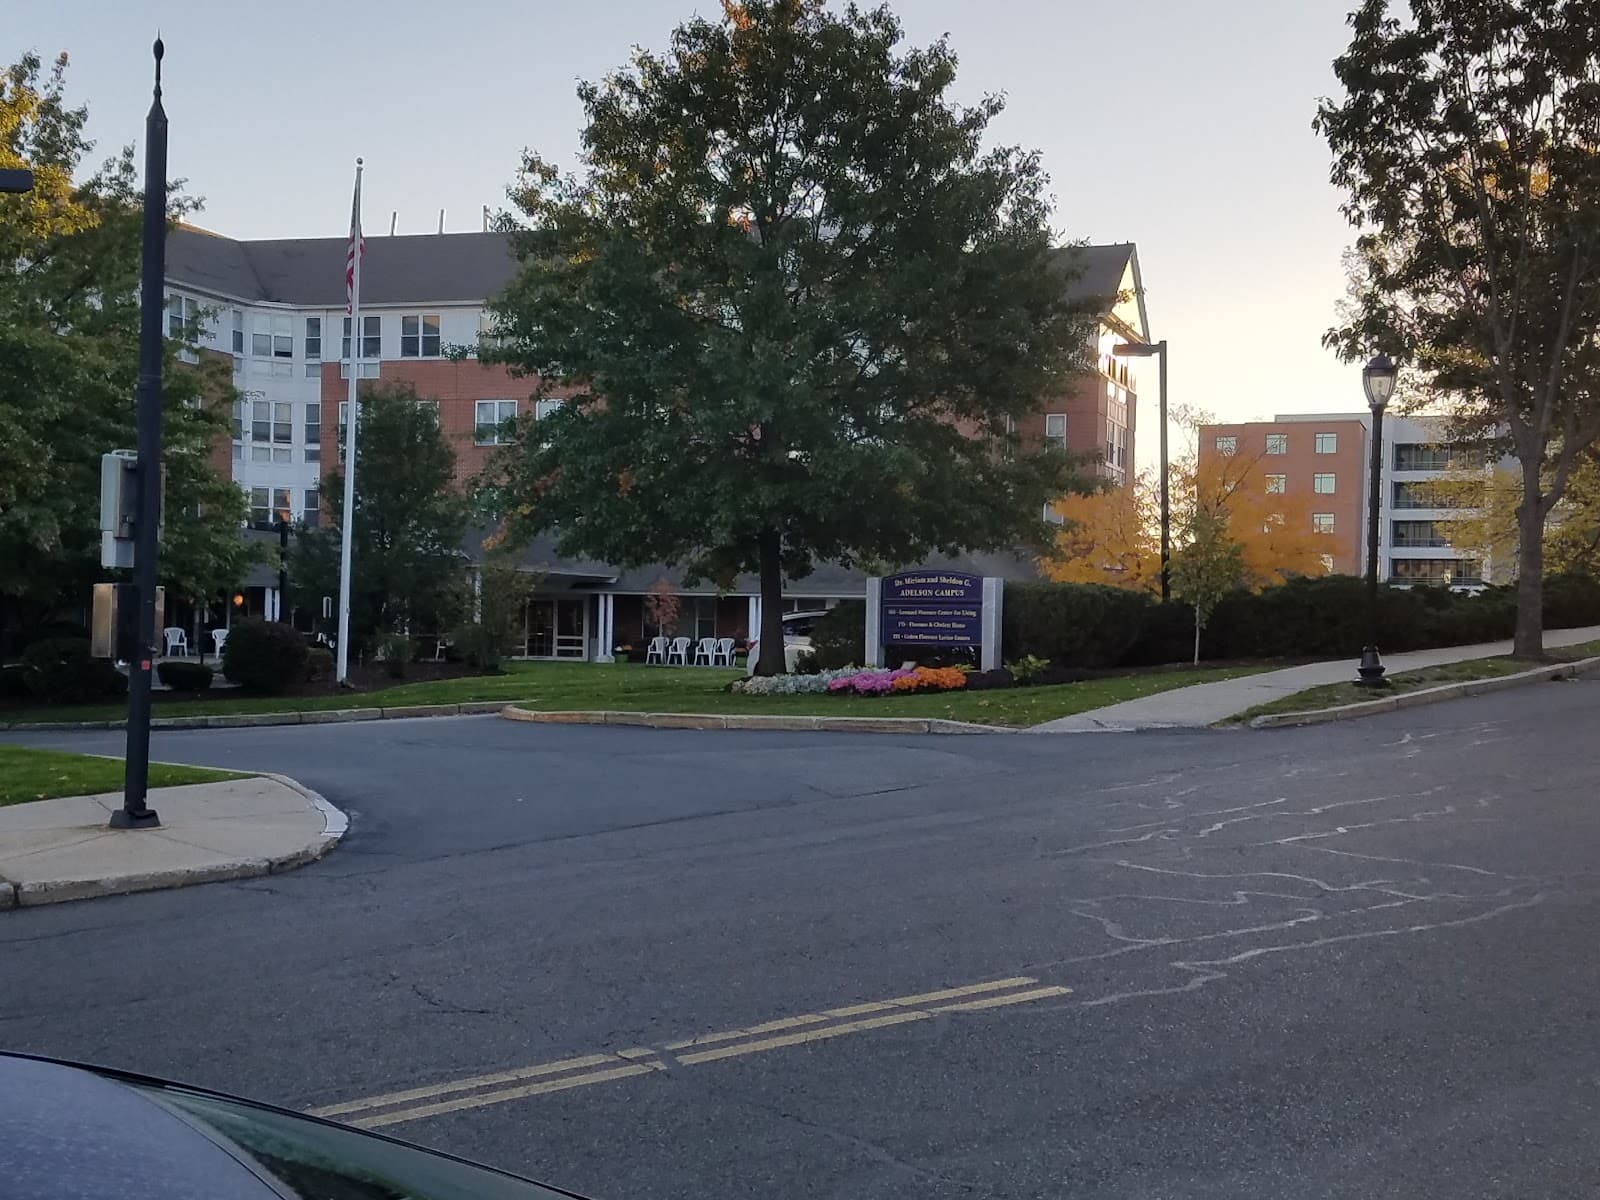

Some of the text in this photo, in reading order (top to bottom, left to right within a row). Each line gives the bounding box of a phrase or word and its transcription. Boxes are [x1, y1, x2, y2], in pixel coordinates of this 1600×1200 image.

[926, 576, 938, 584] and
[900, 589, 965, 597] ADELSON CAMPUS
